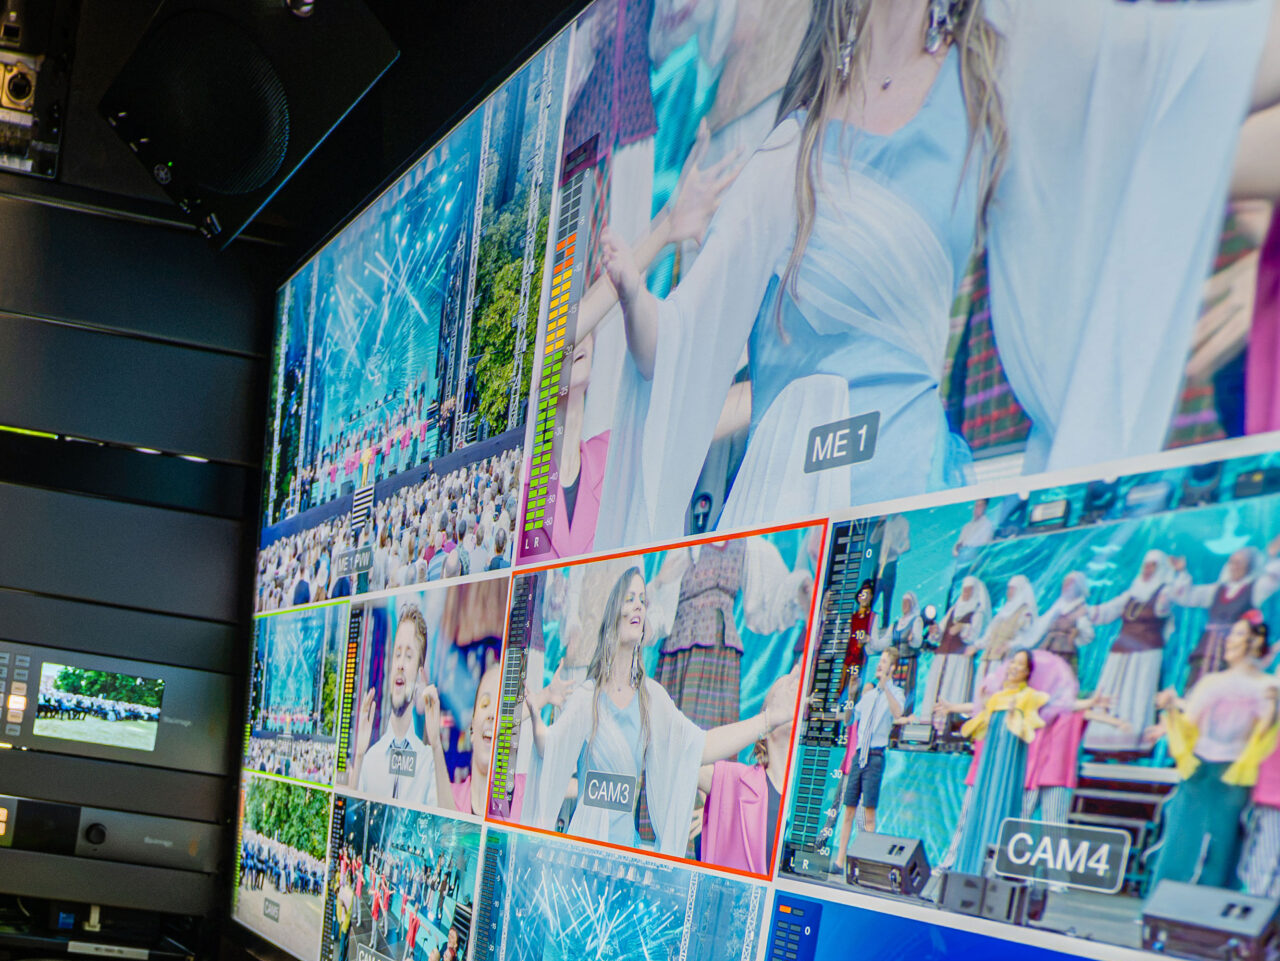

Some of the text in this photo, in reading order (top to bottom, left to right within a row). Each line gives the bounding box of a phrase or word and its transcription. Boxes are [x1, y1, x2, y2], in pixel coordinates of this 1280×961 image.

[812, 424, 868, 463] ME 1
[524, 535, 540, 550] L R
[866, 549, 872, 559] 0
[851, 629, 865, 640] -10
[846, 665, 859, 676] -15
[840, 700, 854, 711] -20
[834, 734, 848, 745] -25
[392, 753, 415, 772] CAM2
[829, 769, 843, 779] -30
[588, 779, 630, 804] CAM3
[1006, 831, 1111, 877] CAM4
[790, 856, 809, 870] L R
[804, 926, 811, 935] 0
